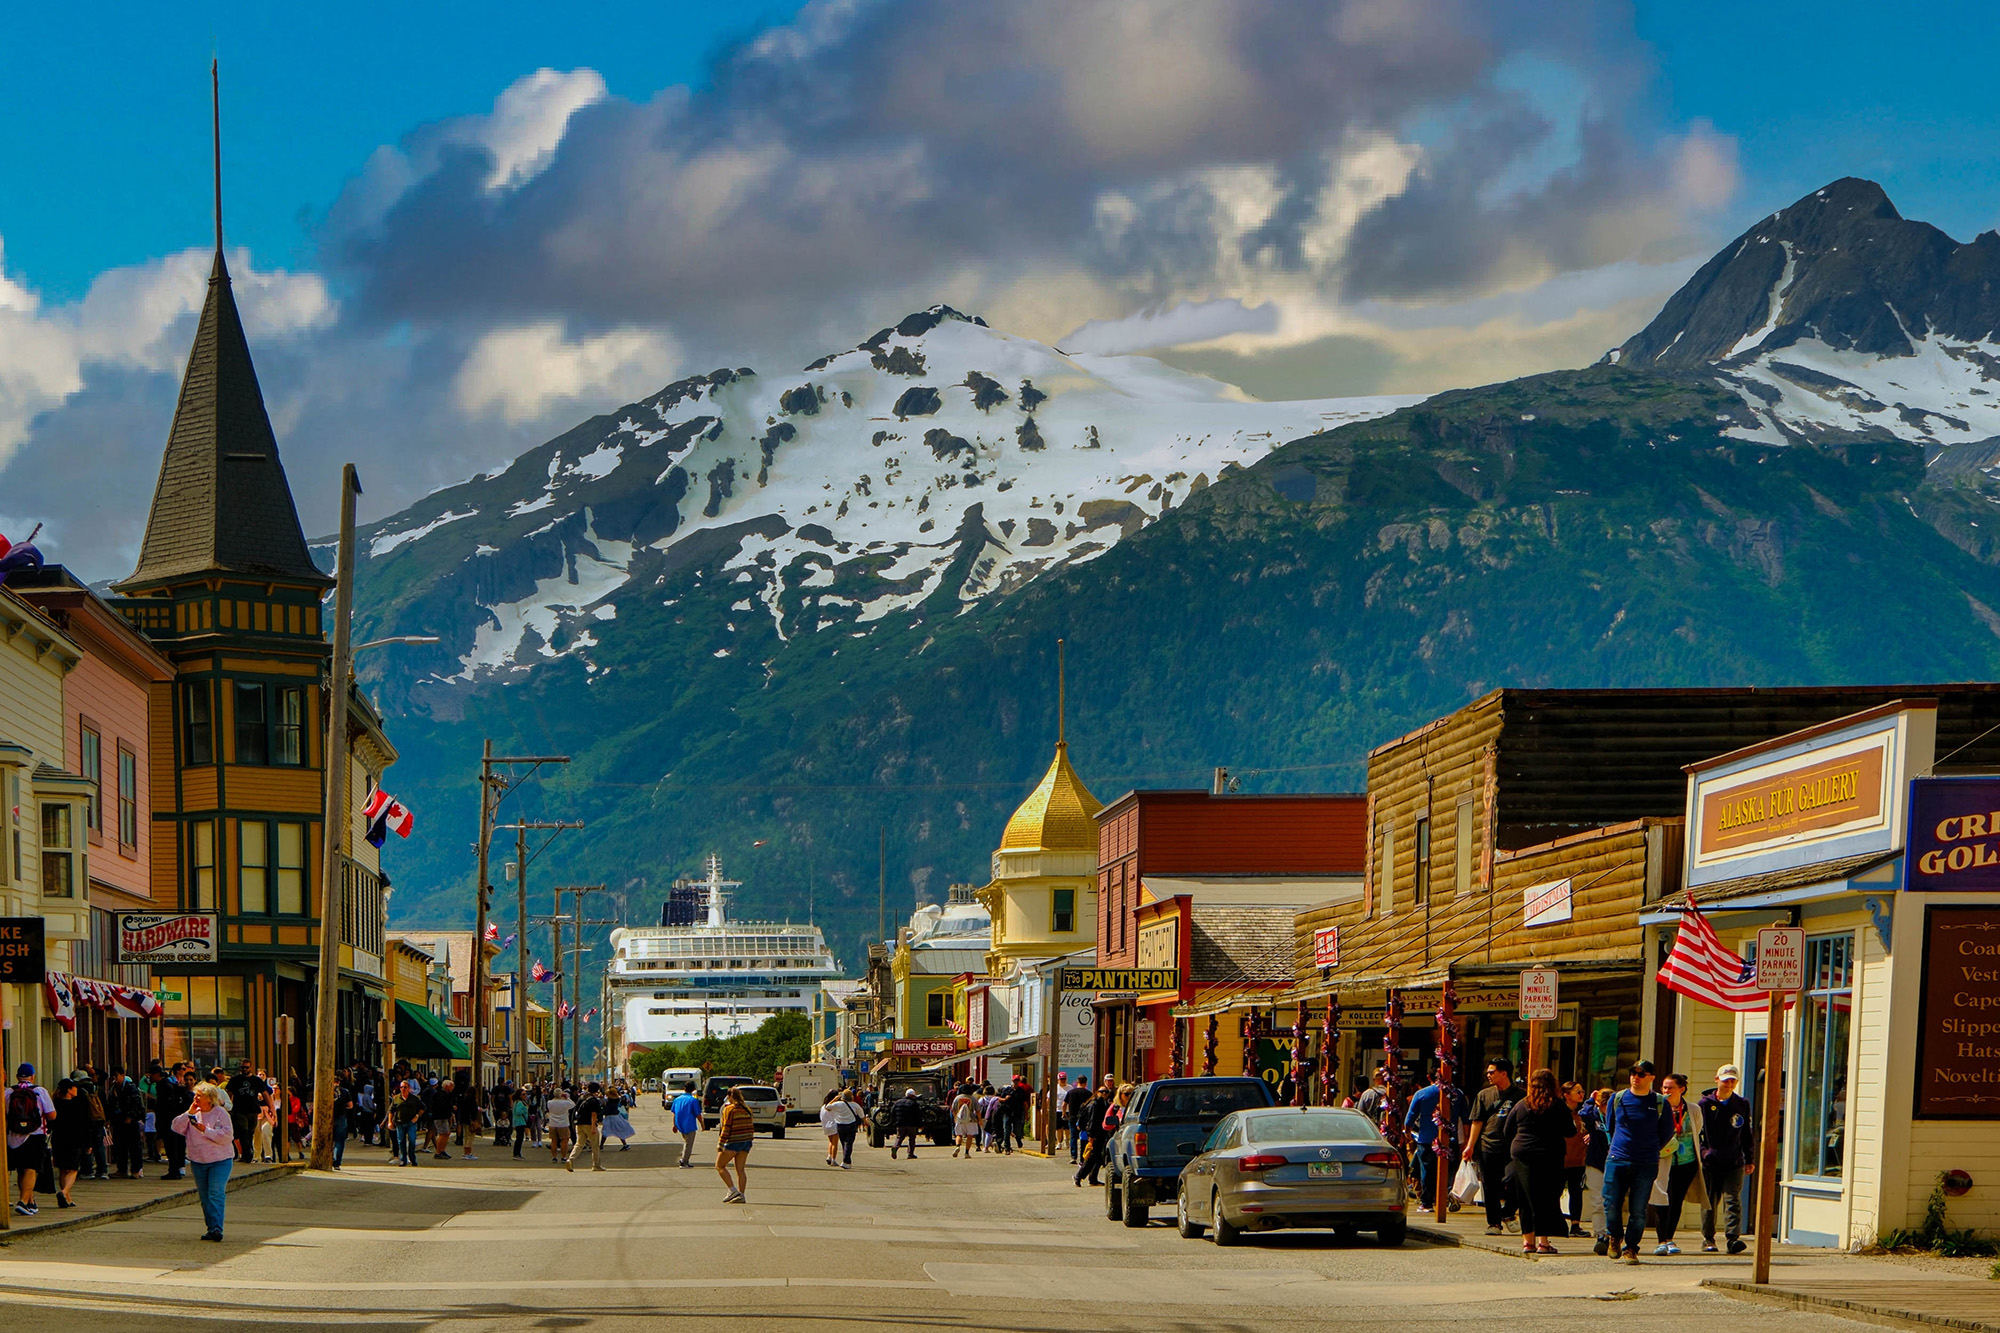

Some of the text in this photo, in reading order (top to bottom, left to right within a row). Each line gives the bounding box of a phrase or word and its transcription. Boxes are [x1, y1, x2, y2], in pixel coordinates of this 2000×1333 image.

[1718, 769, 1860, 831] ALASKA FUR GALLERY
[1919, 843, 2000, 874] GOL
[122, 917, 210, 952] HARDWARE
[1774, 935, 1788, 946] 20
[182, 942, 196, 950] CO.
[120, 953, 175, 961] SPORTING
[1765, 948, 1795, 957] MINUTE
[1762, 960, 1798, 969] PARKING
[1081, 971, 1174, 988] PANTHEON
[1533, 975, 1545, 984] 20
[1060, 991, 1094, 1007] Hea
[1524, 995, 1552, 1003] PARKING
[895, 1043, 954, 1051] MINER'S GEMS
[1957, 1042, 2000, 1057] Hats
